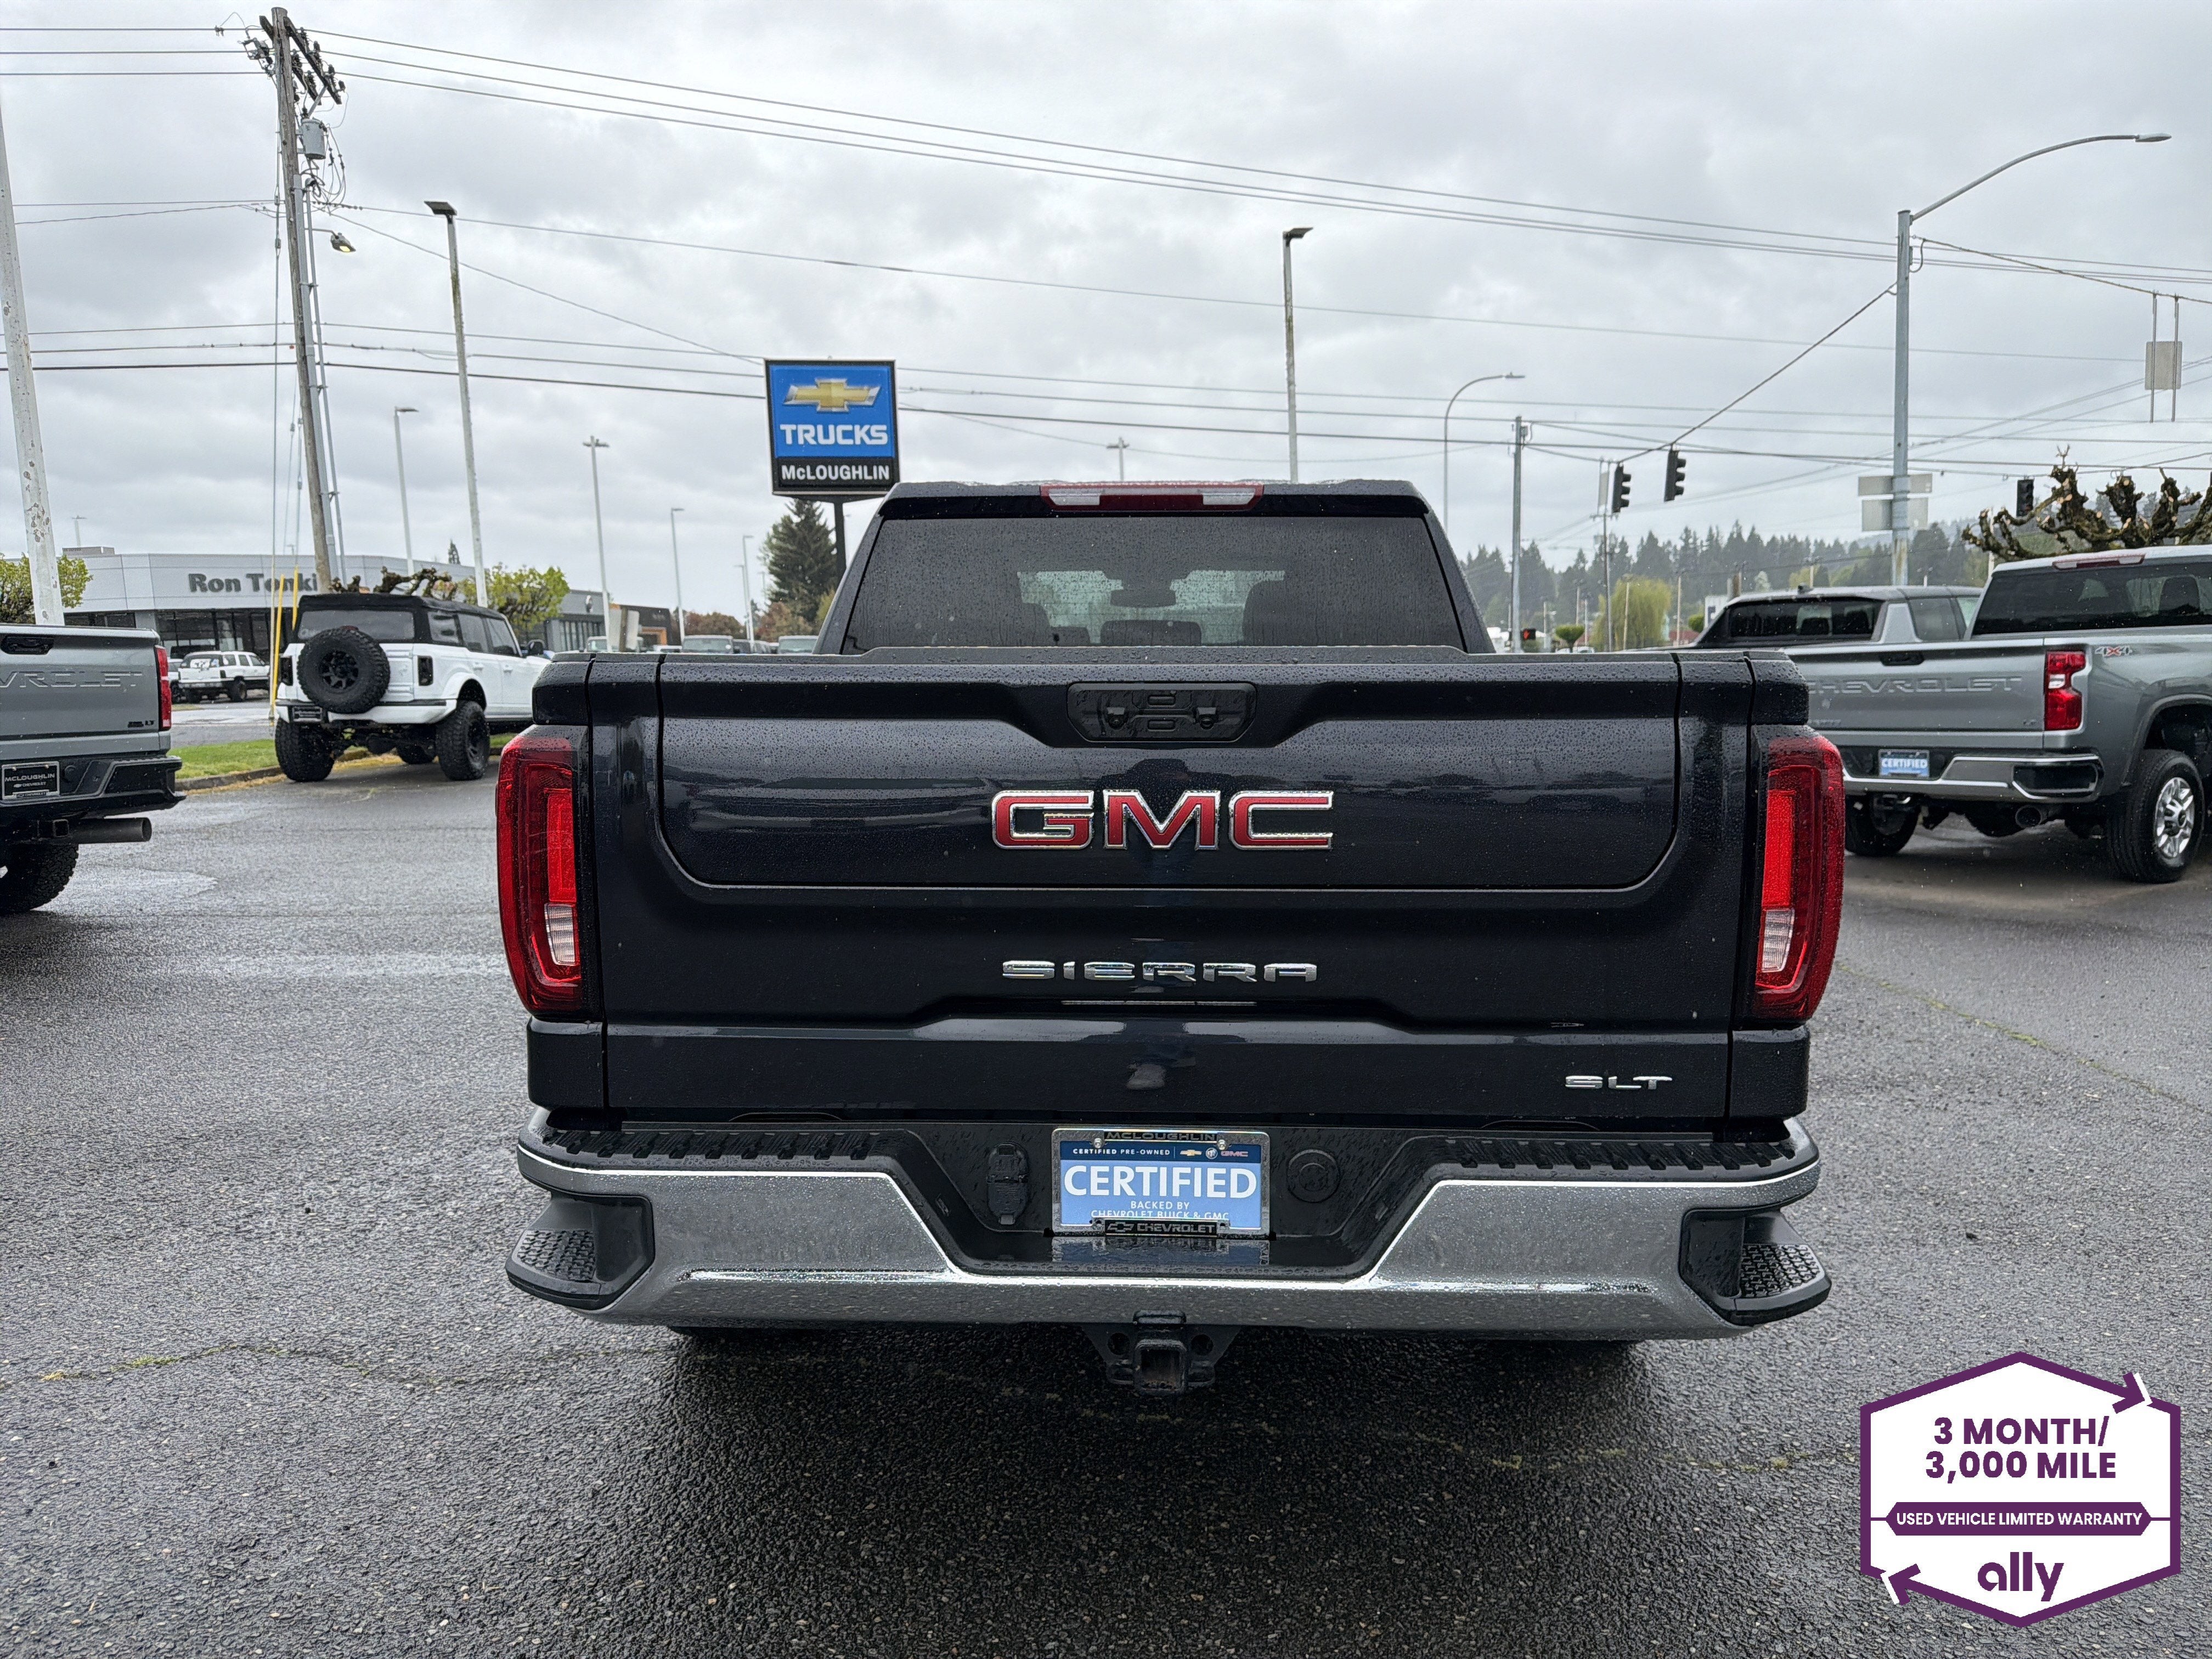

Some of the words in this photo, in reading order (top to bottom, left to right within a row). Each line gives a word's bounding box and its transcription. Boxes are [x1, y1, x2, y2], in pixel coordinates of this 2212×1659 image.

[780, 424, 888, 445] TRUCKS
[781, 465, 890, 480] McLOUGHLIN
[188, 573, 241, 592] Ron
[246, 573, 318, 592] Tonki
[5, 772, 55, 782] MCLOUGHLIN
[991, 789, 1334, 850] GMC
[1002, 960, 1318, 982] SIERRA
[1565, 1075, 1673, 1090] SLT
[1106, 1132, 1216, 1141] MCLOUGHLIN
[1064, 1165, 1257, 1199] CERTIFIED
[1130, 1200, 1173, 1210] BACKED
[1177, 1201, 1190, 1210] BY
[1137, 1223, 1215, 1233] CHEVROLET
